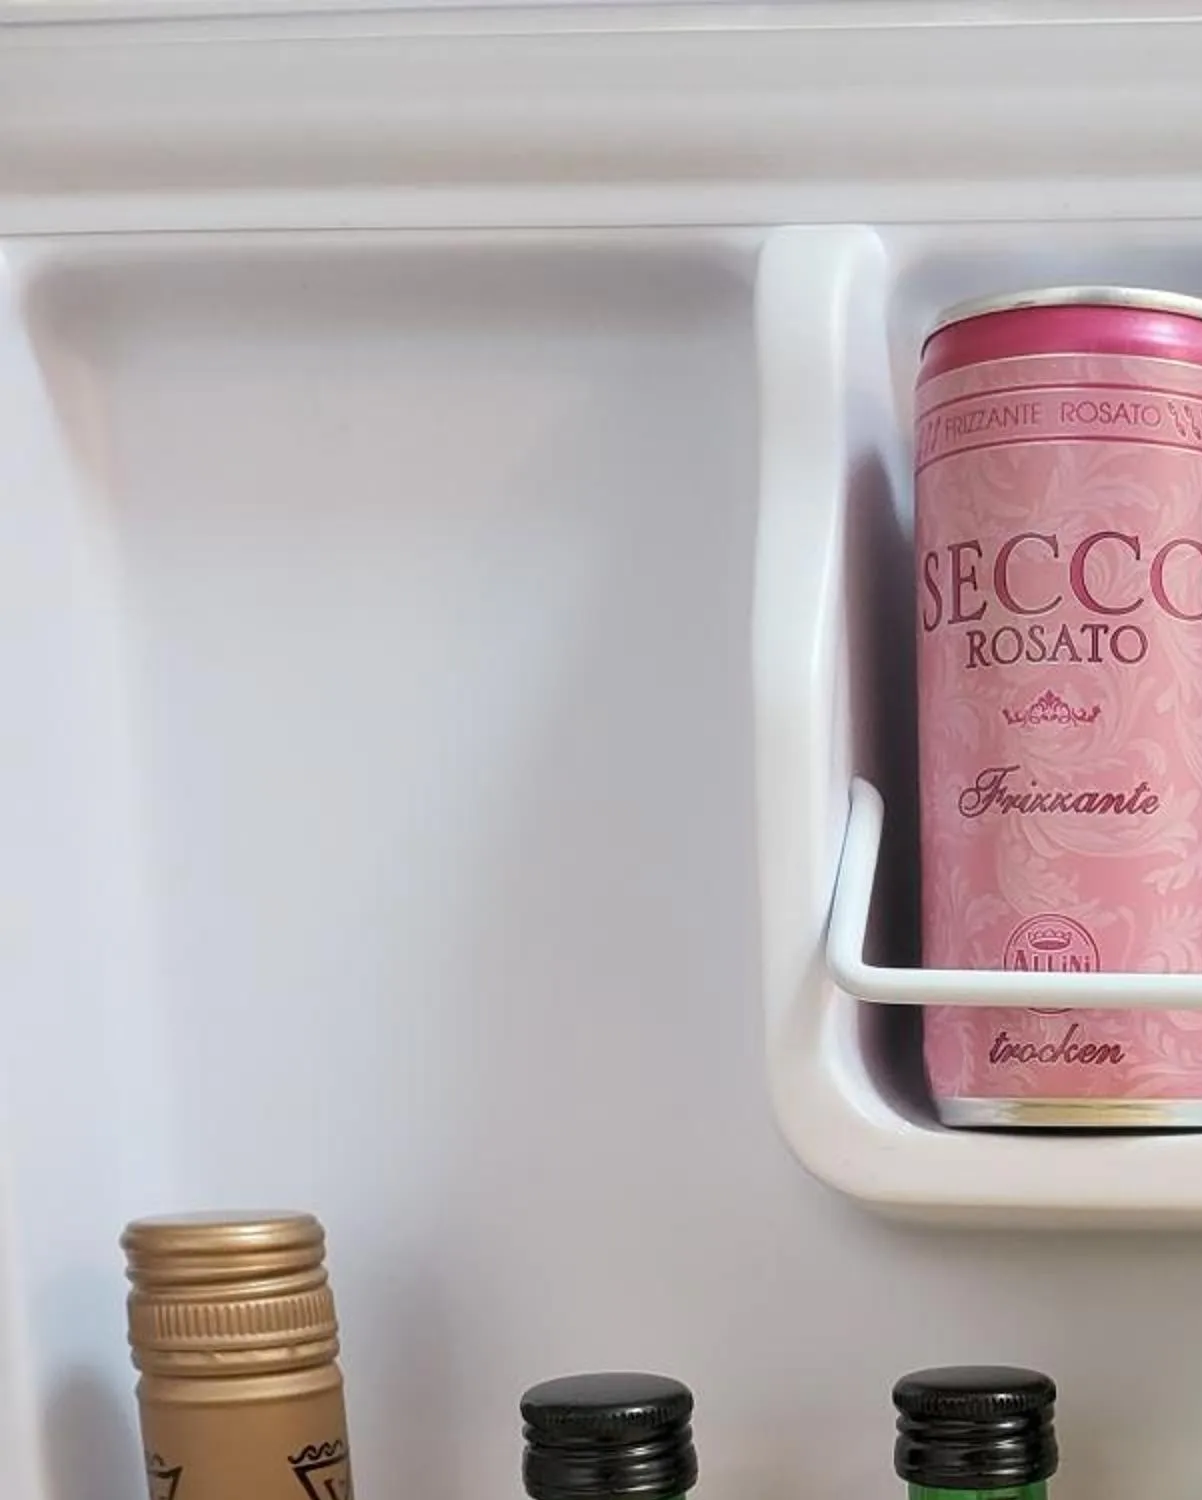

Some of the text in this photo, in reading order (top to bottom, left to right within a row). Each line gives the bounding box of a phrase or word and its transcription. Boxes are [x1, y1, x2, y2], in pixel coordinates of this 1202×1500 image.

[944, 399, 1163, 440] FRIZZANTE ROSATO
[964, 622, 1150, 670] ROSATO
[958, 764, 1161, 819] Frizzante
[988, 1022, 1126, 1065] trocken
